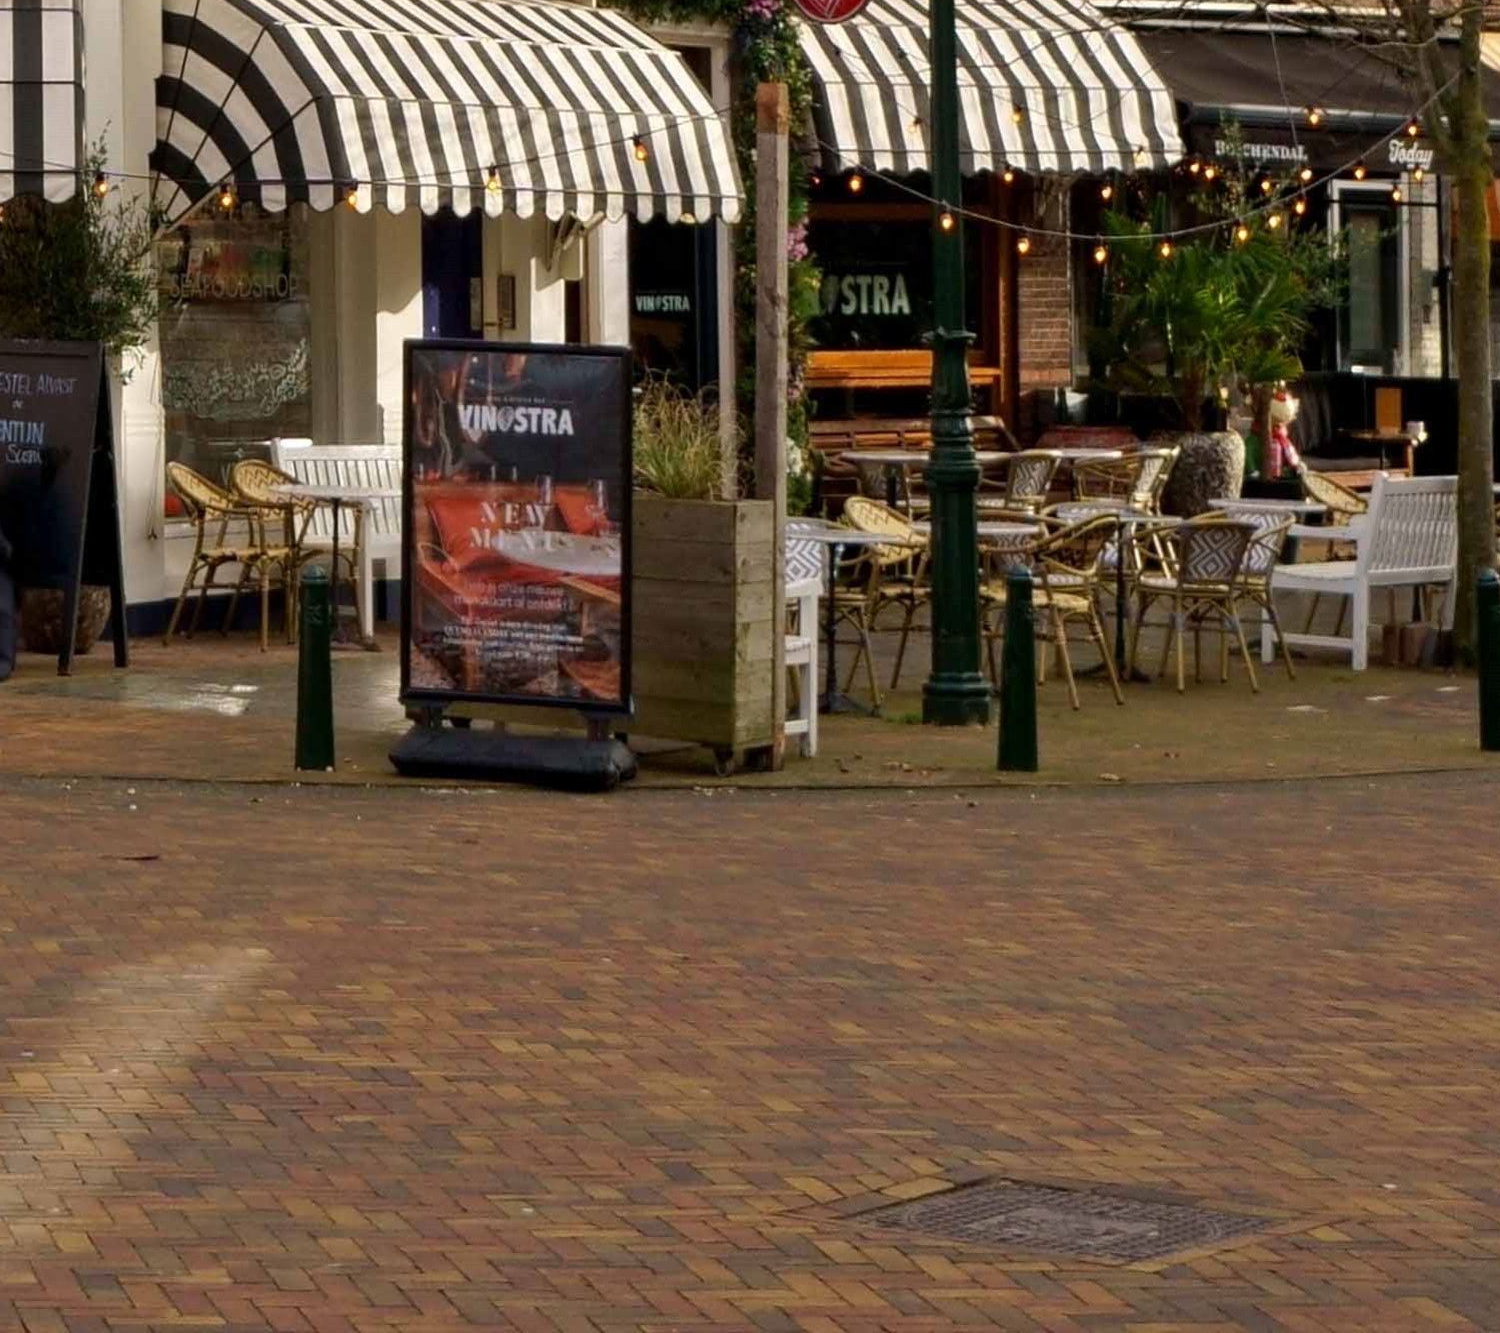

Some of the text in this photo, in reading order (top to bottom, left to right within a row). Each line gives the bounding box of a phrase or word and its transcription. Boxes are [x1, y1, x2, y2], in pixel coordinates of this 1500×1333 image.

[1215, 140, 1309, 162] BOCHENDAL
[1388, 139, 1434, 168] Today
[169, 272, 298, 299] SEAFOODSHOP
[480, 501, 549, 525] NEW
